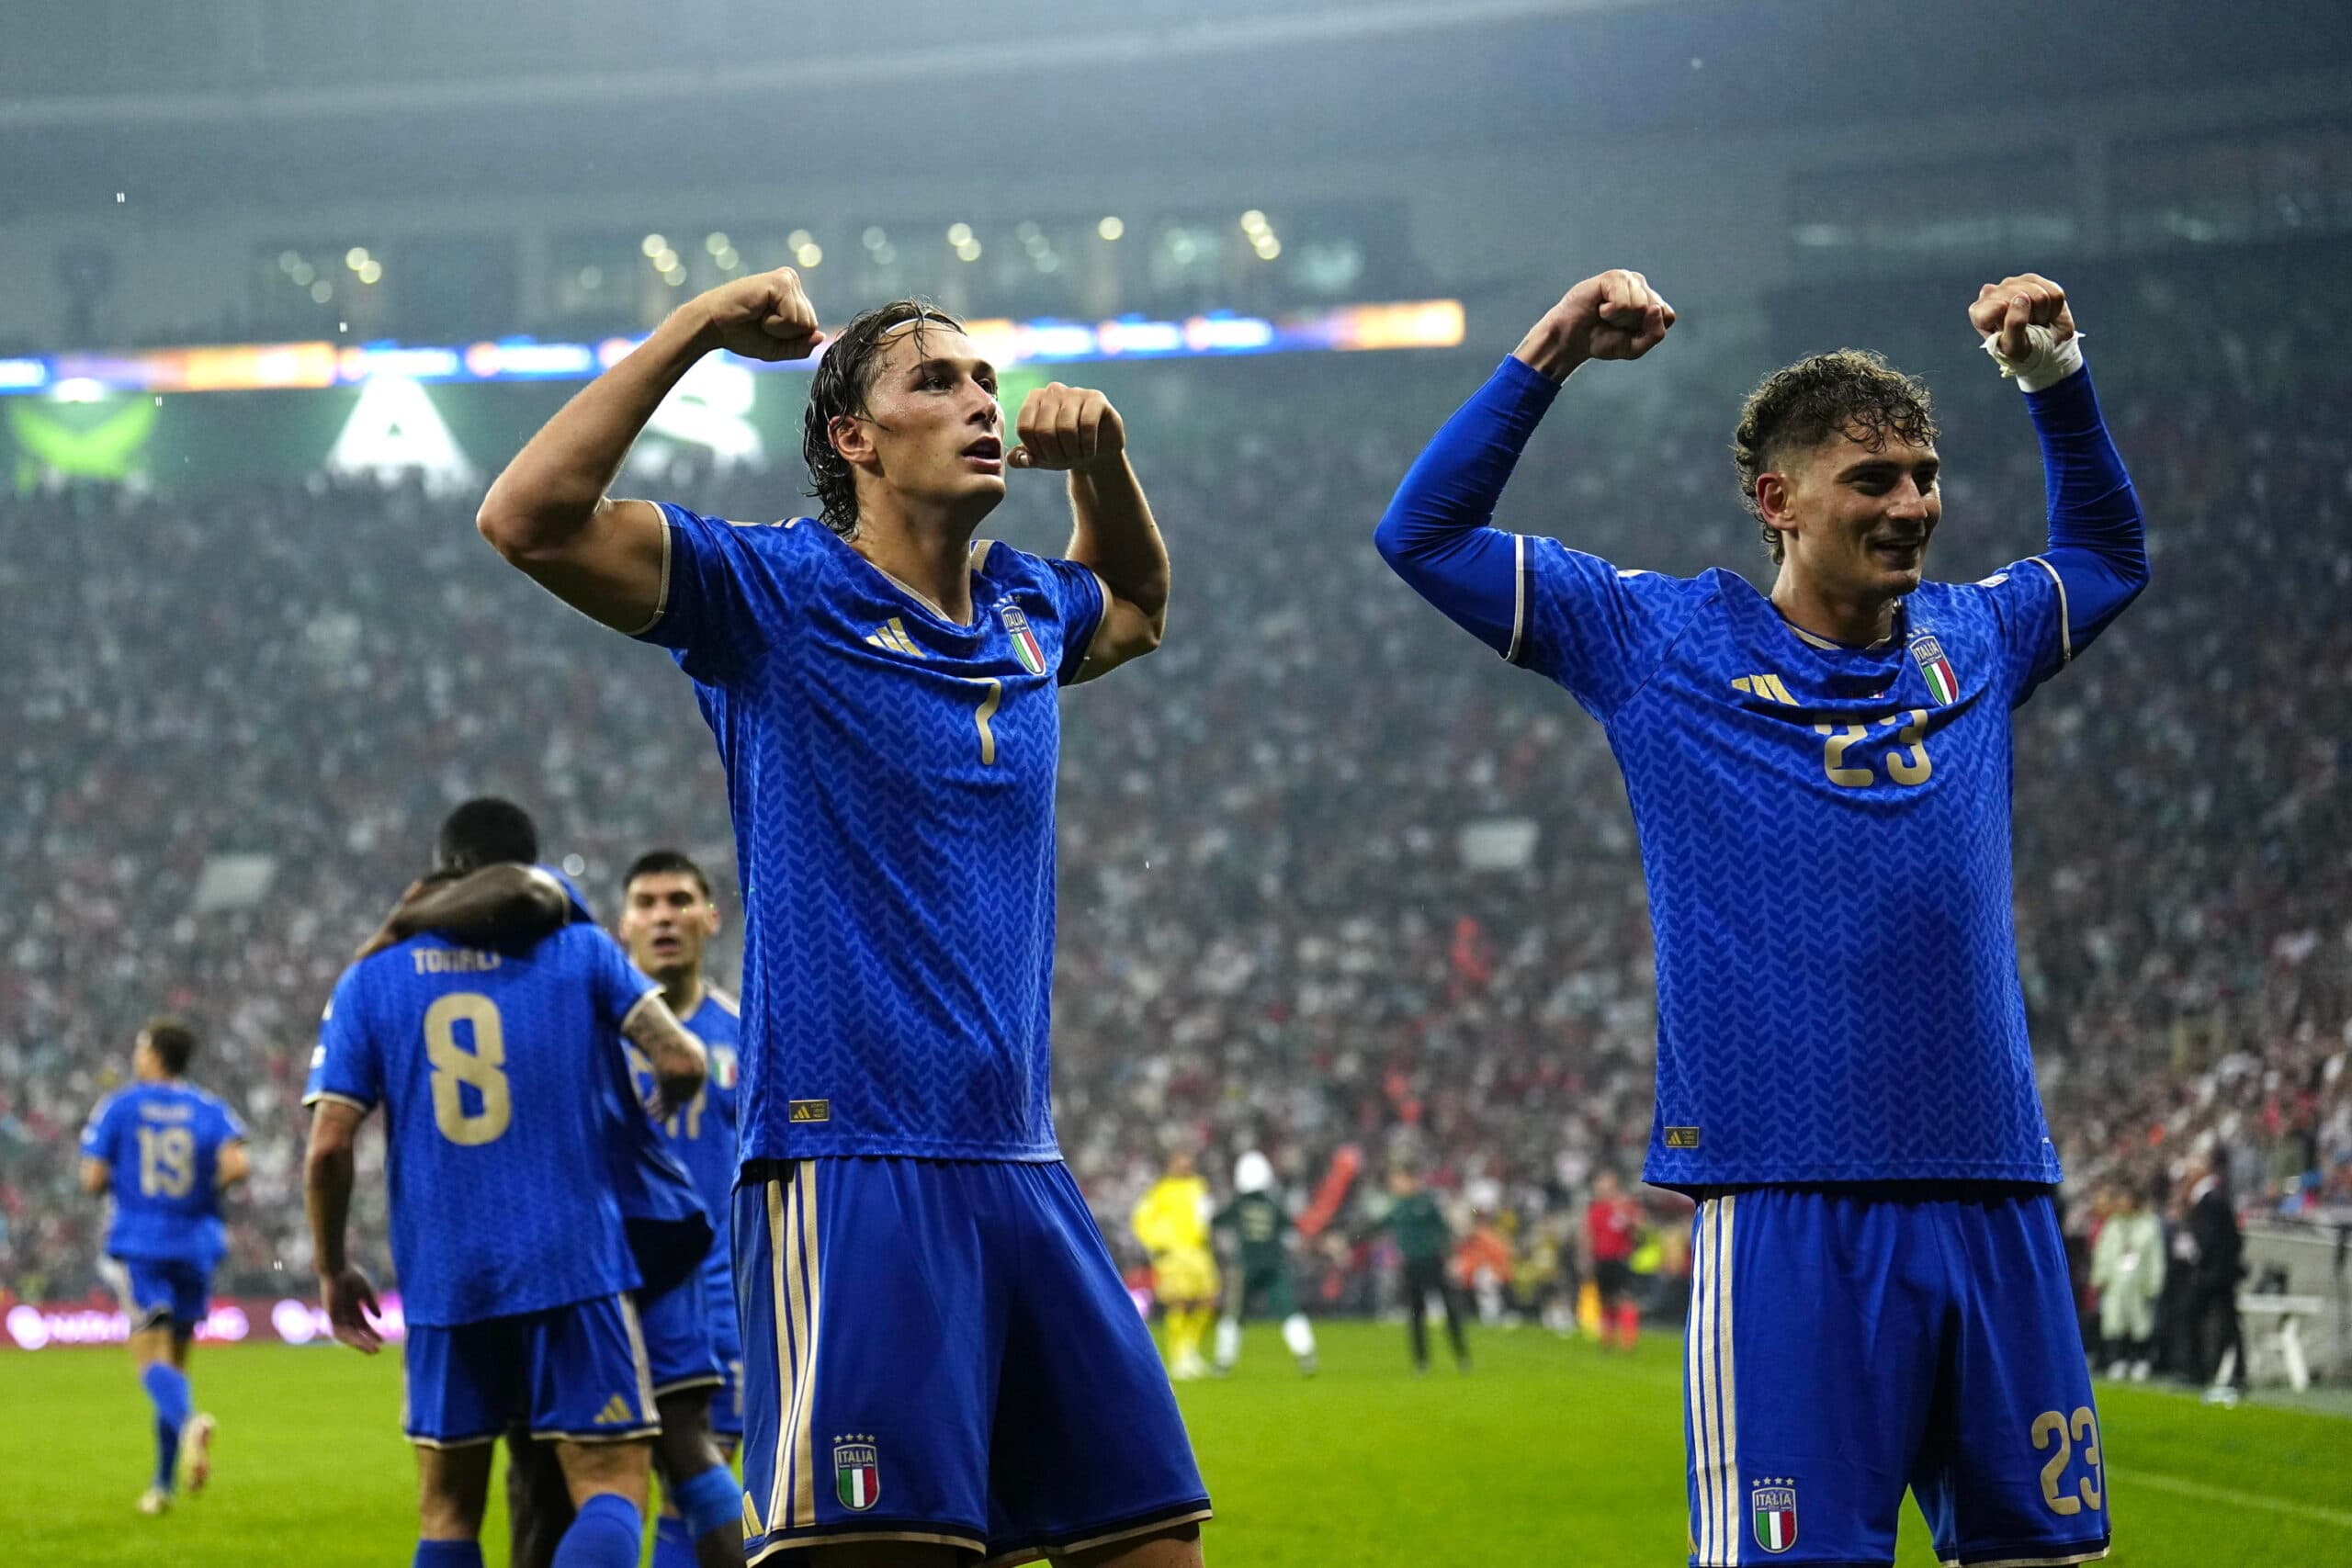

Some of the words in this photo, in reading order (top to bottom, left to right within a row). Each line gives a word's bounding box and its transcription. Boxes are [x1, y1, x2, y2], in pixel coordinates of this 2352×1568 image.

[1003, 612, 1025, 627] ITALIA
[1912, 641, 1940, 661] ITALIA
[958, 677, 1001, 765] 7
[1814, 709, 1932, 787] 23
[424, 992, 512, 1146] 8
[138, 1127, 196, 1197] 19
[837, 1450, 874, 1463] ITALIA
[2031, 1406, 2101, 1516] 23
[1756, 1493, 1792, 1506] ITALIA
